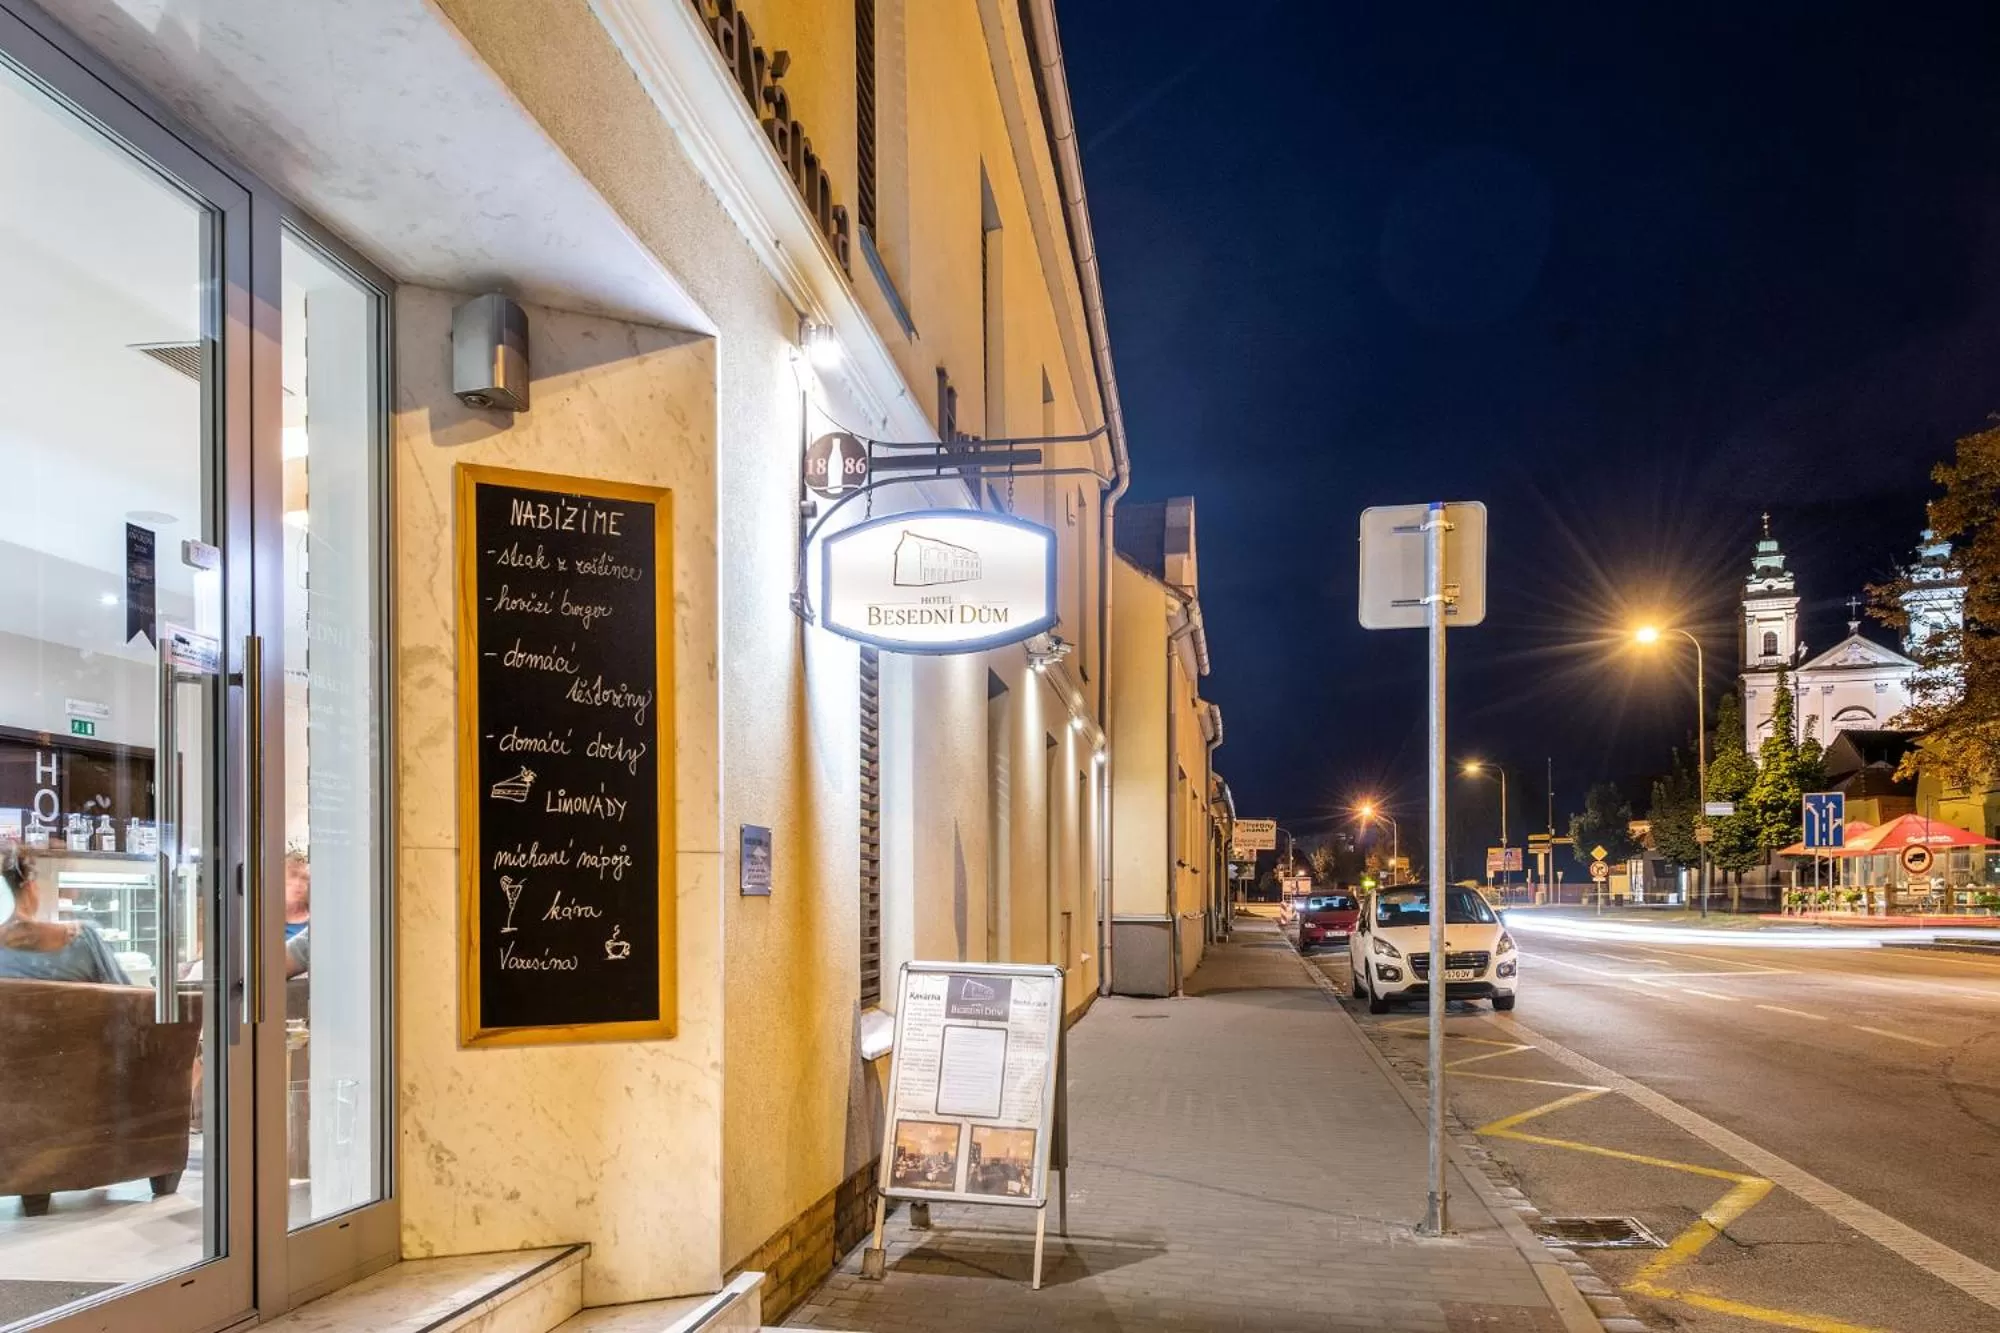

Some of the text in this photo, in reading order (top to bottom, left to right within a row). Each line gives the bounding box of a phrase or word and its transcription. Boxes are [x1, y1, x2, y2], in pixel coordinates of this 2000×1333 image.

[690, 0, 853, 282] avárna
[844, 456, 867, 475] 86
[510, 497, 625, 537] NABÍZÍME
[497, 541, 550, 570] steak
[494, 584, 555, 614] hovězí
[561, 588, 613, 630] burger
[868, 604, 1009, 626] BESEDNÍ DŮM
[920, 596, 953, 605] HOTEL
[503, 638, 580, 674] domácí
[566, 675, 654, 725] těstoviny
[499, 726, 574, 756] domácí
[586, 731, 646, 777] dorty
[493, 838, 633, 882] míchané nápoje
[541, 890, 603, 921] káva
